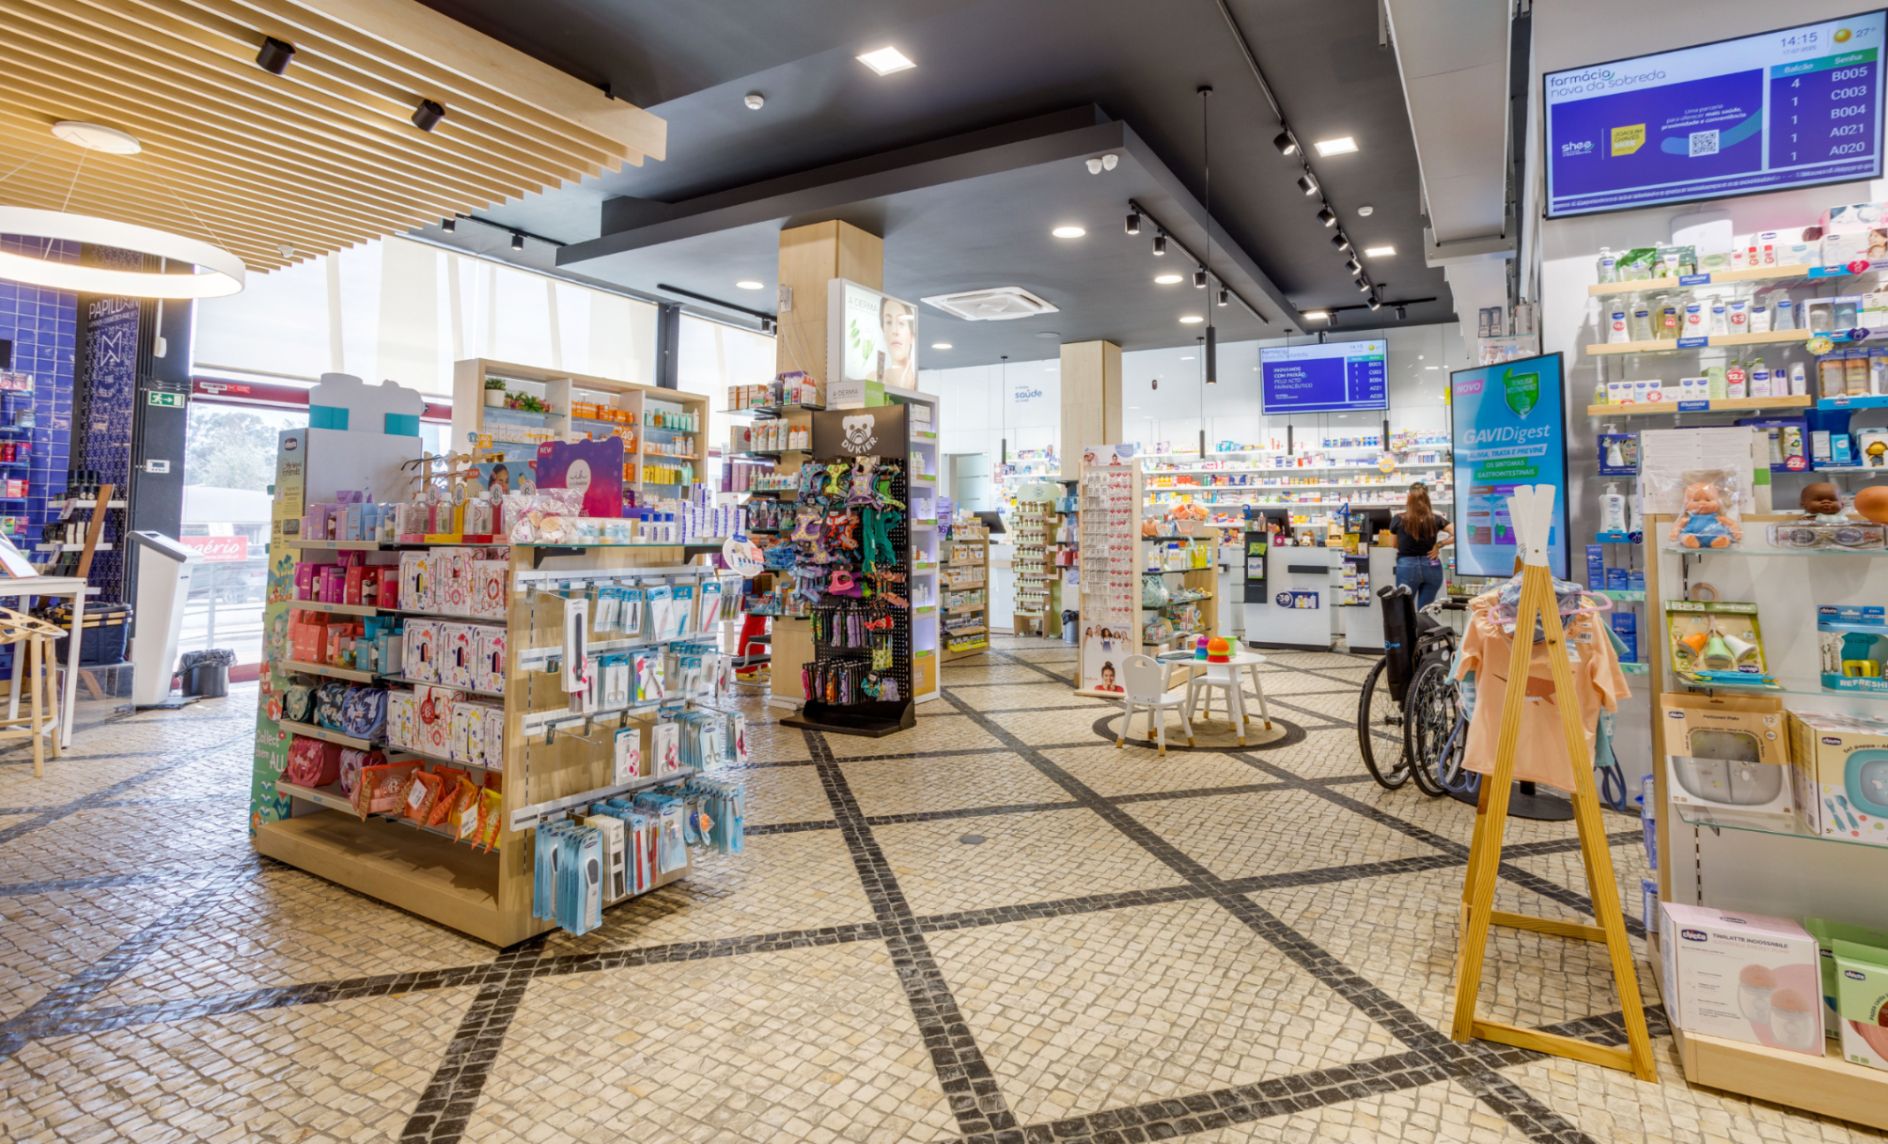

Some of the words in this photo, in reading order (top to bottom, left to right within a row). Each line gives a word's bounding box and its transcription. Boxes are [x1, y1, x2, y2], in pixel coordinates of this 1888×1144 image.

[1780, 32, 1818, 47] 14:15
[1551, 69, 1614, 87] farmácia
[1551, 84, 1583, 97] nova
[1586, 80, 1605, 92] da
[1608, 70, 1667, 88] sobreda
[1791, 78, 1800, 88] 4
[1832, 66, 1868, 82] B005
[1791, 97, 1799, 107] 1
[1831, 86, 1867, 101] C003
[1791, 115, 1798, 125] 1
[1831, 104, 1866, 119] B004
[1791, 133, 1798, 143] 1
[1829, 123, 1864, 138] A021
[1790, 151, 1797, 161] 1
[1829, 142, 1865, 156] A020
[1456, 382, 1481, 393] NOVO
[1463, 424, 1551, 444] GAVIDigest
[1336, 502, 1351, 516] 4
[1682, 929, 1707, 942] chicco
